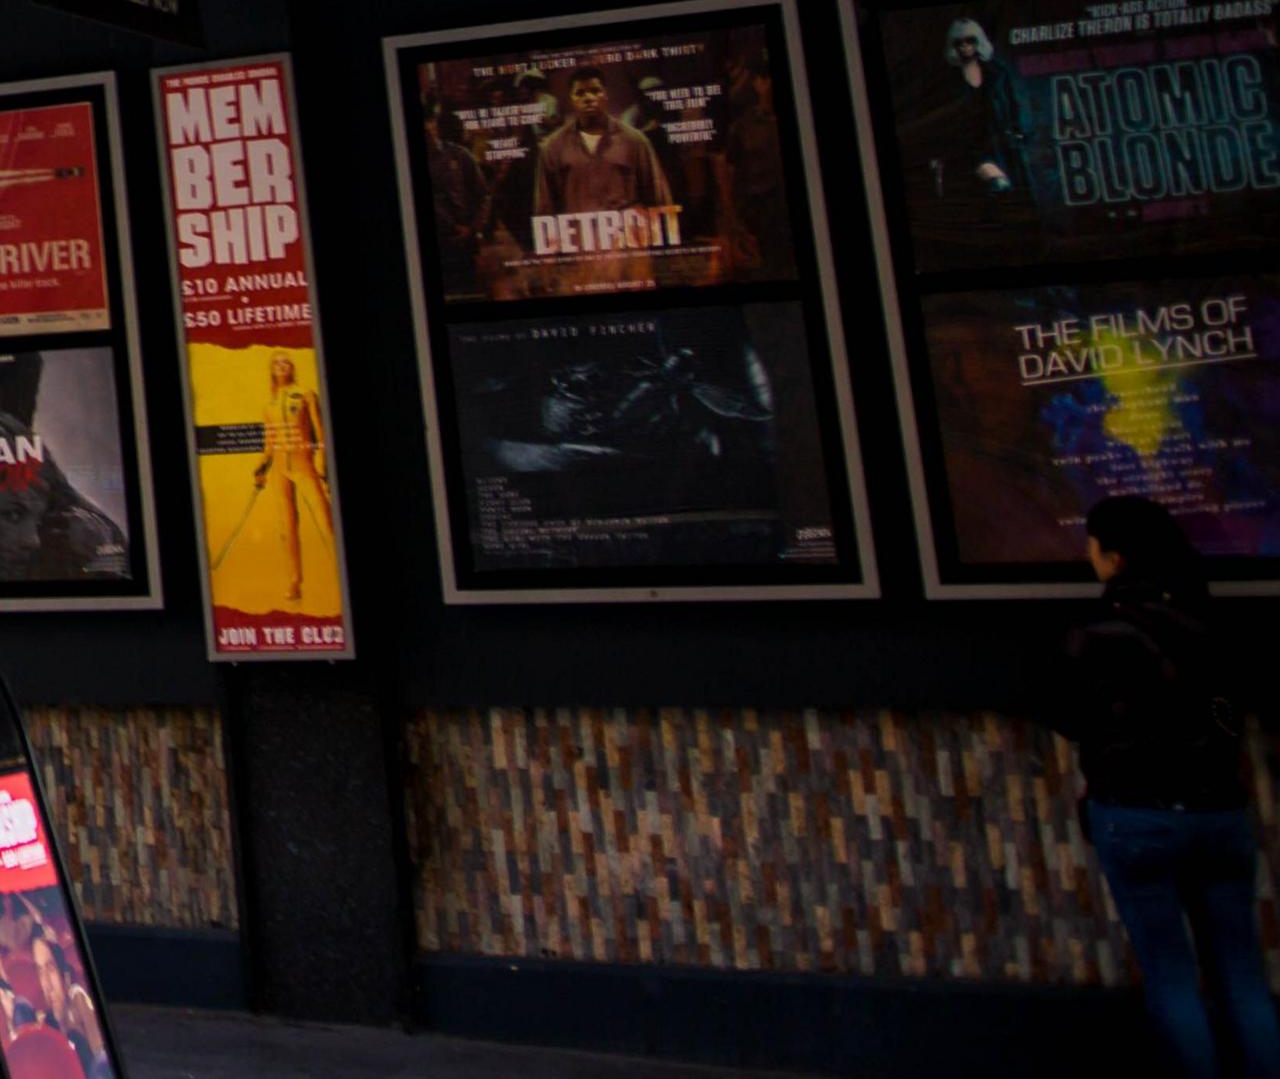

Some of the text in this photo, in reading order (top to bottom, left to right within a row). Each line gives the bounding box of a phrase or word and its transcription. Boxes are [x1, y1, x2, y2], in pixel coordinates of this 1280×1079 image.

[1010, 22, 1076, 45] CHARLIZE
[1077, 16, 1133, 38] THERON
[165, 78, 288, 145] MEM
[1050, 53, 1269, 141] ATOMIC
[171, 137, 295, 211] BER
[1055, 120, 1280, 207] BLONDE
[176, 204, 300, 269] SHIP
[531, 204, 683, 256] DETROIT
[182, 270, 309, 297] £10 ANNUAL
[227, 302, 313, 325] LIFETIME
[1014, 294, 1248, 351] THE FILMS OF
[1018, 324, 1255, 380] DAVID LYNCH
[218, 627, 258, 646] JOIN
[262, 627, 295, 645] THE
